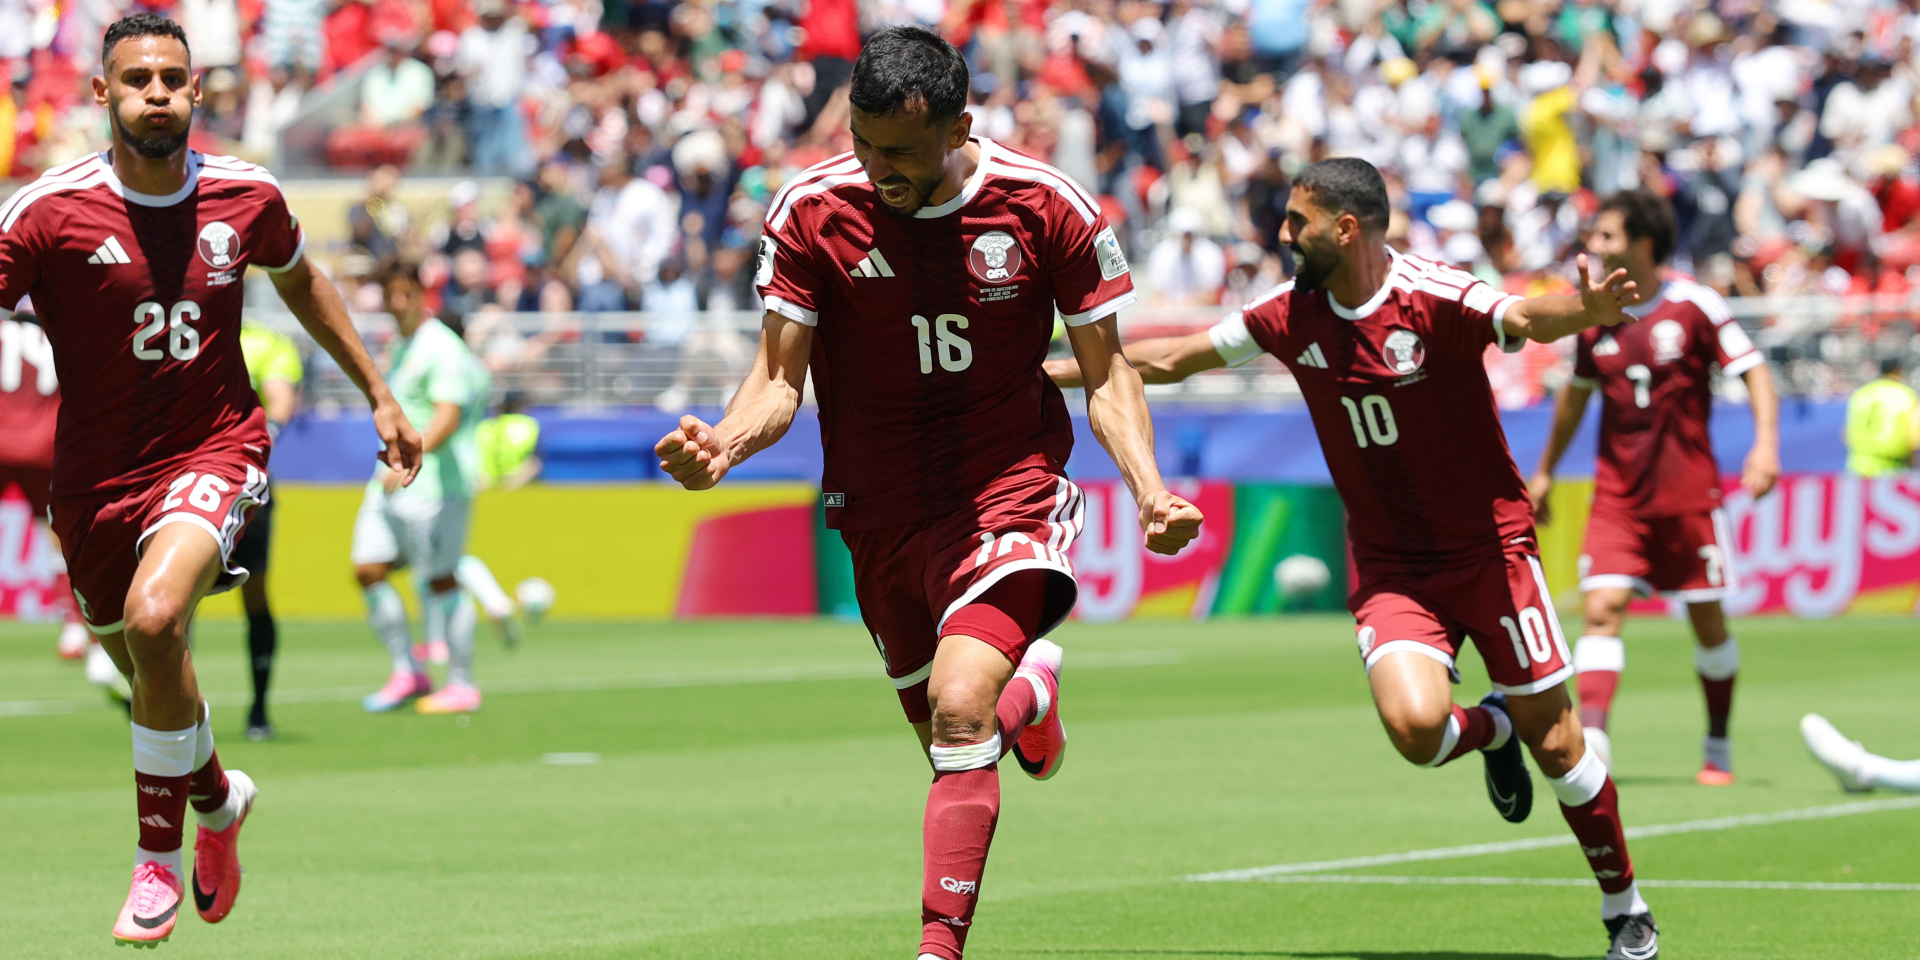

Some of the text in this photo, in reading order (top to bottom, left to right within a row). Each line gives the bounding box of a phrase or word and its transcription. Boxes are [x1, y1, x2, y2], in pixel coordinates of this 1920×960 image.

[986, 268, 1009, 279] QFA
[133, 300, 201, 361] 26
[911, 313, 973, 374] 16
[1625, 363, 1652, 409] 7
[1340, 394, 1399, 448] 10
[162, 471, 231, 513] 26
[1499, 605, 1552, 670] 10
[940, 876, 976, 895] QFA
